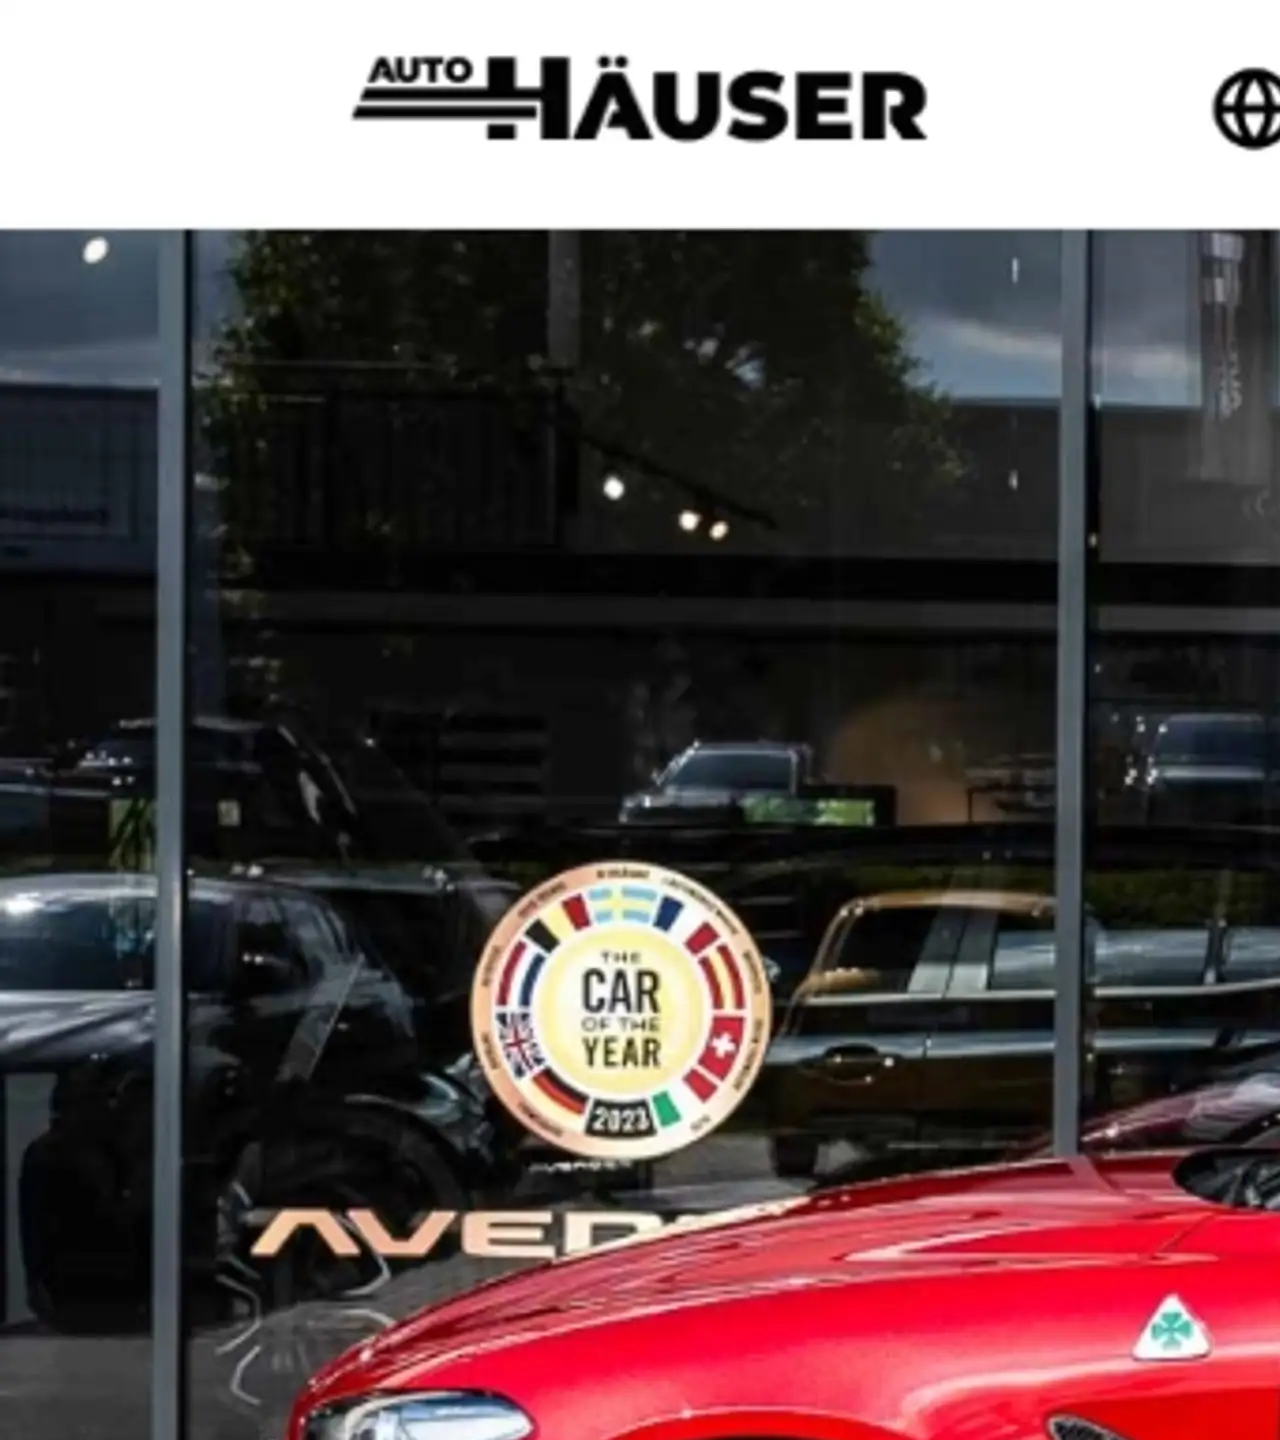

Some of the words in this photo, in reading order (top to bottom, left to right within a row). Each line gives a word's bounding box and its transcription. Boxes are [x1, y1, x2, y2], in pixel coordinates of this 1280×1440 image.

[602, 952, 641, 964] THE
[582, 967, 660, 1014] CAR
[581, 1017, 610, 1032] OF
[617, 1017, 660, 1032] THE
[582, 1036, 661, 1068] YEAR
[592, 1107, 650, 1132] 2023
